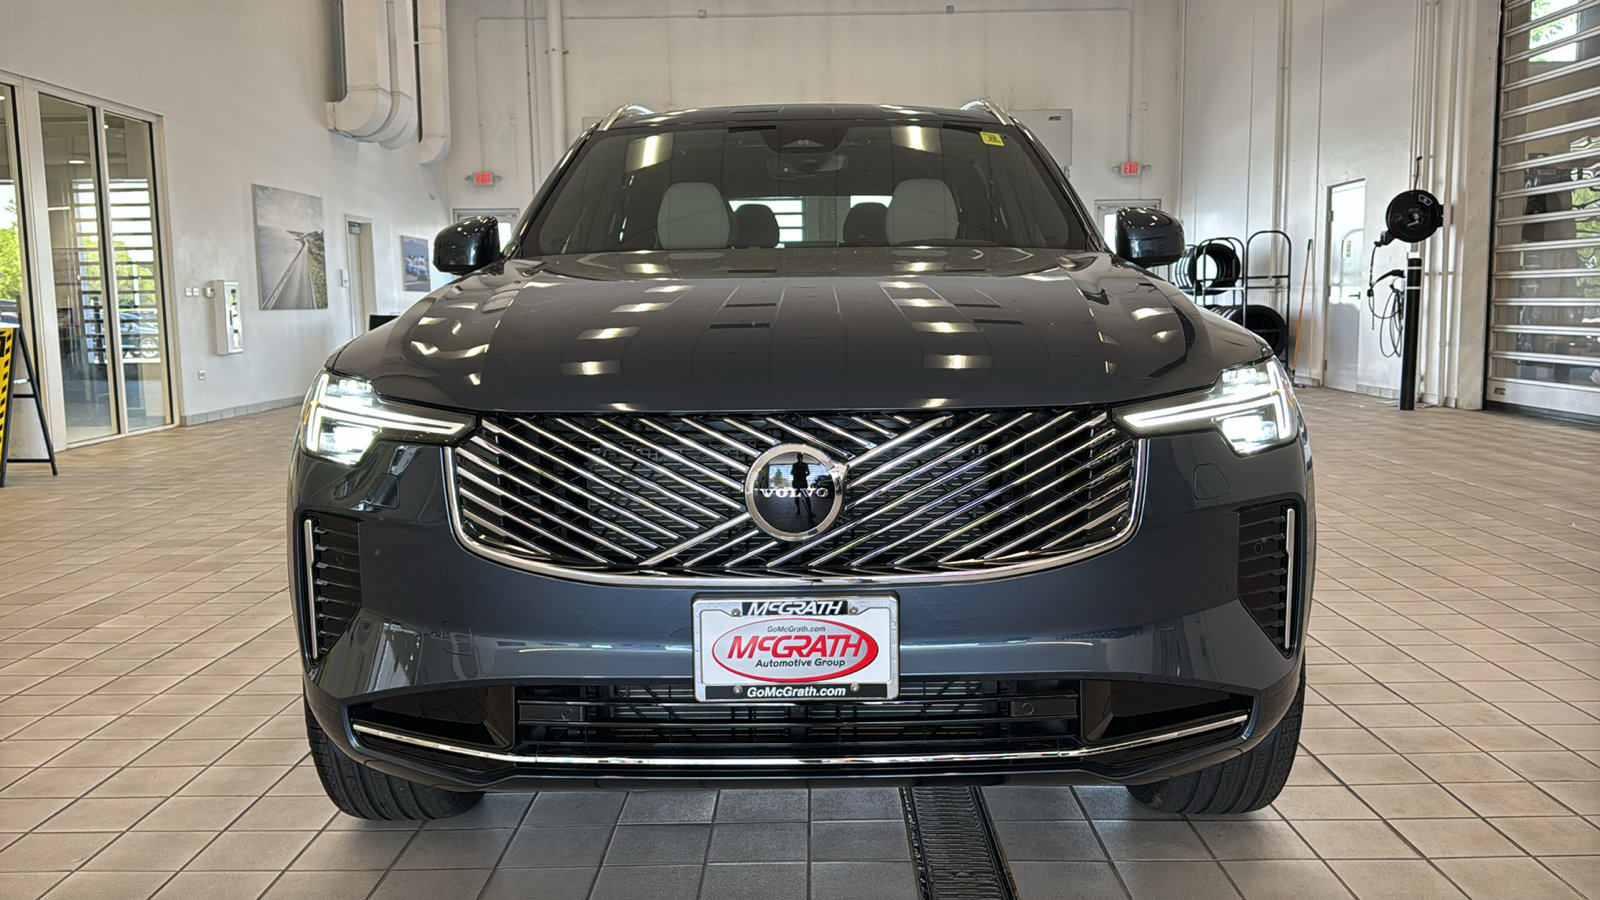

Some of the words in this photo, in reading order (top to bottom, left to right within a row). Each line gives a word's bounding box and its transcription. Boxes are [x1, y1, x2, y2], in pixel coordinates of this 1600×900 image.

[1124, 162, 1138, 174] EXIT
[475, 172, 490, 184] EXIT
[760, 488, 828, 497] VOLVO
[767, 625, 826, 633] GoMcGrath.com
[755, 658, 812, 668] Automotive
[814, 658, 846, 668] Group
[746, 686, 846, 698] GoMcGrath.com
